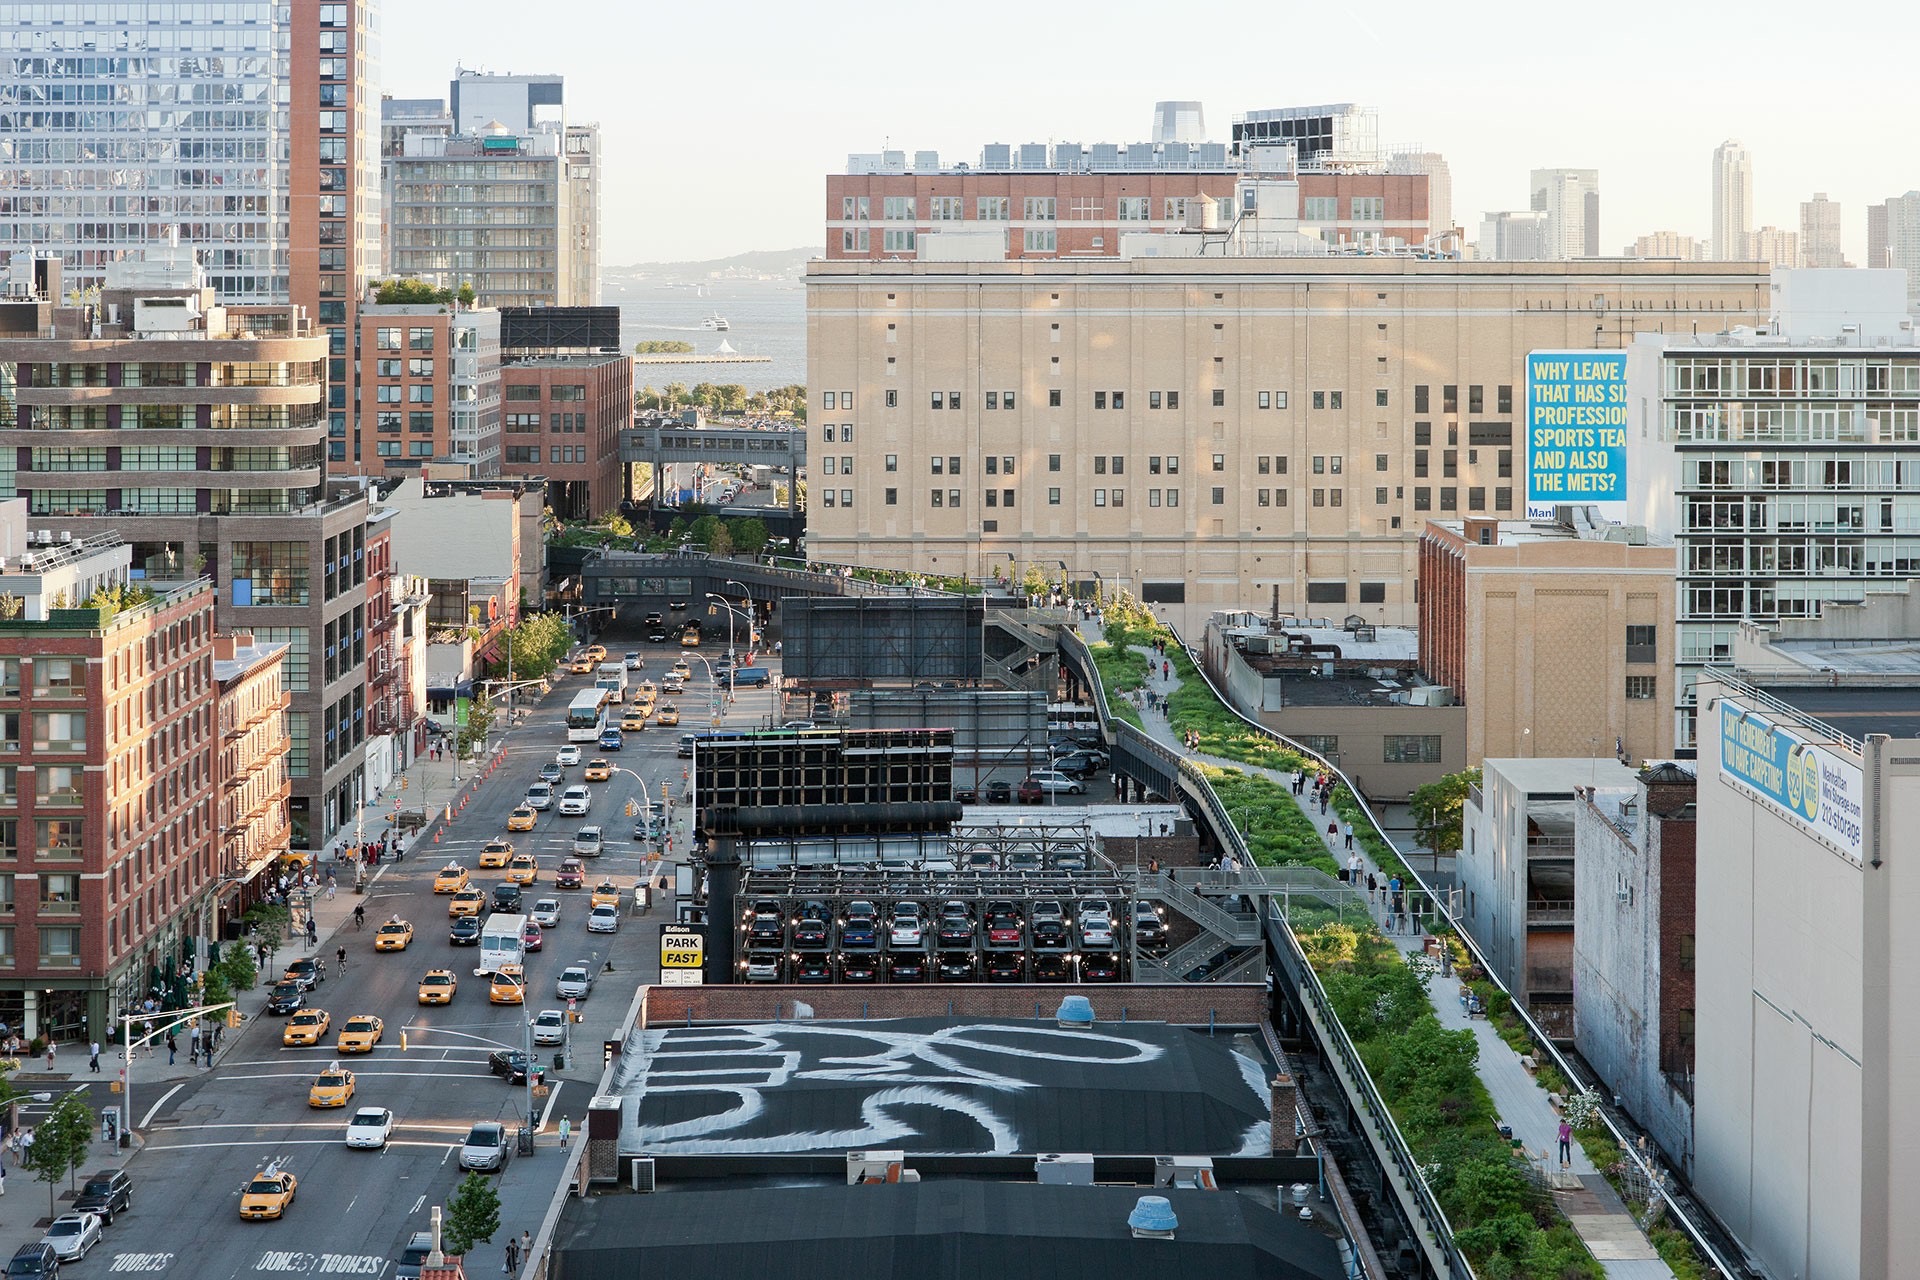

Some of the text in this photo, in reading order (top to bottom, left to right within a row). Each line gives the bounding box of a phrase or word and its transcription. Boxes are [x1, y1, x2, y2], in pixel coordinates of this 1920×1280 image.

[1533, 362, 1569, 380] WHY
[1574, 362, 1619, 380] LEAVE
[1534, 384, 1571, 402] THAT
[1575, 384, 1605, 402] HAS
[1534, 429, 1627, 447] SPORTS TEA
[1534, 451, 1608, 469] AND ALSO
[1534, 473, 1617, 491] THE METS?
[1771, 735, 1777, 762] IF
[1724, 738, 1735, 768] YOU
[1735, 744, 1750, 777] HAVE
[1750, 752, 1783, 796] CARPETING?
[1805, 767, 1816, 786] FREE
[1822, 761, 1848, 792] Manhattan
[1789, 771, 1800, 801] $29
[1805, 784, 1817, 804] MOVE
[666, 938, 698, 948] PARK
[666, 953, 698, 963] FAST
[109, 1253, 174, 1272] SCHOOL
[319, 1253, 383, 1274] SCHOOL
